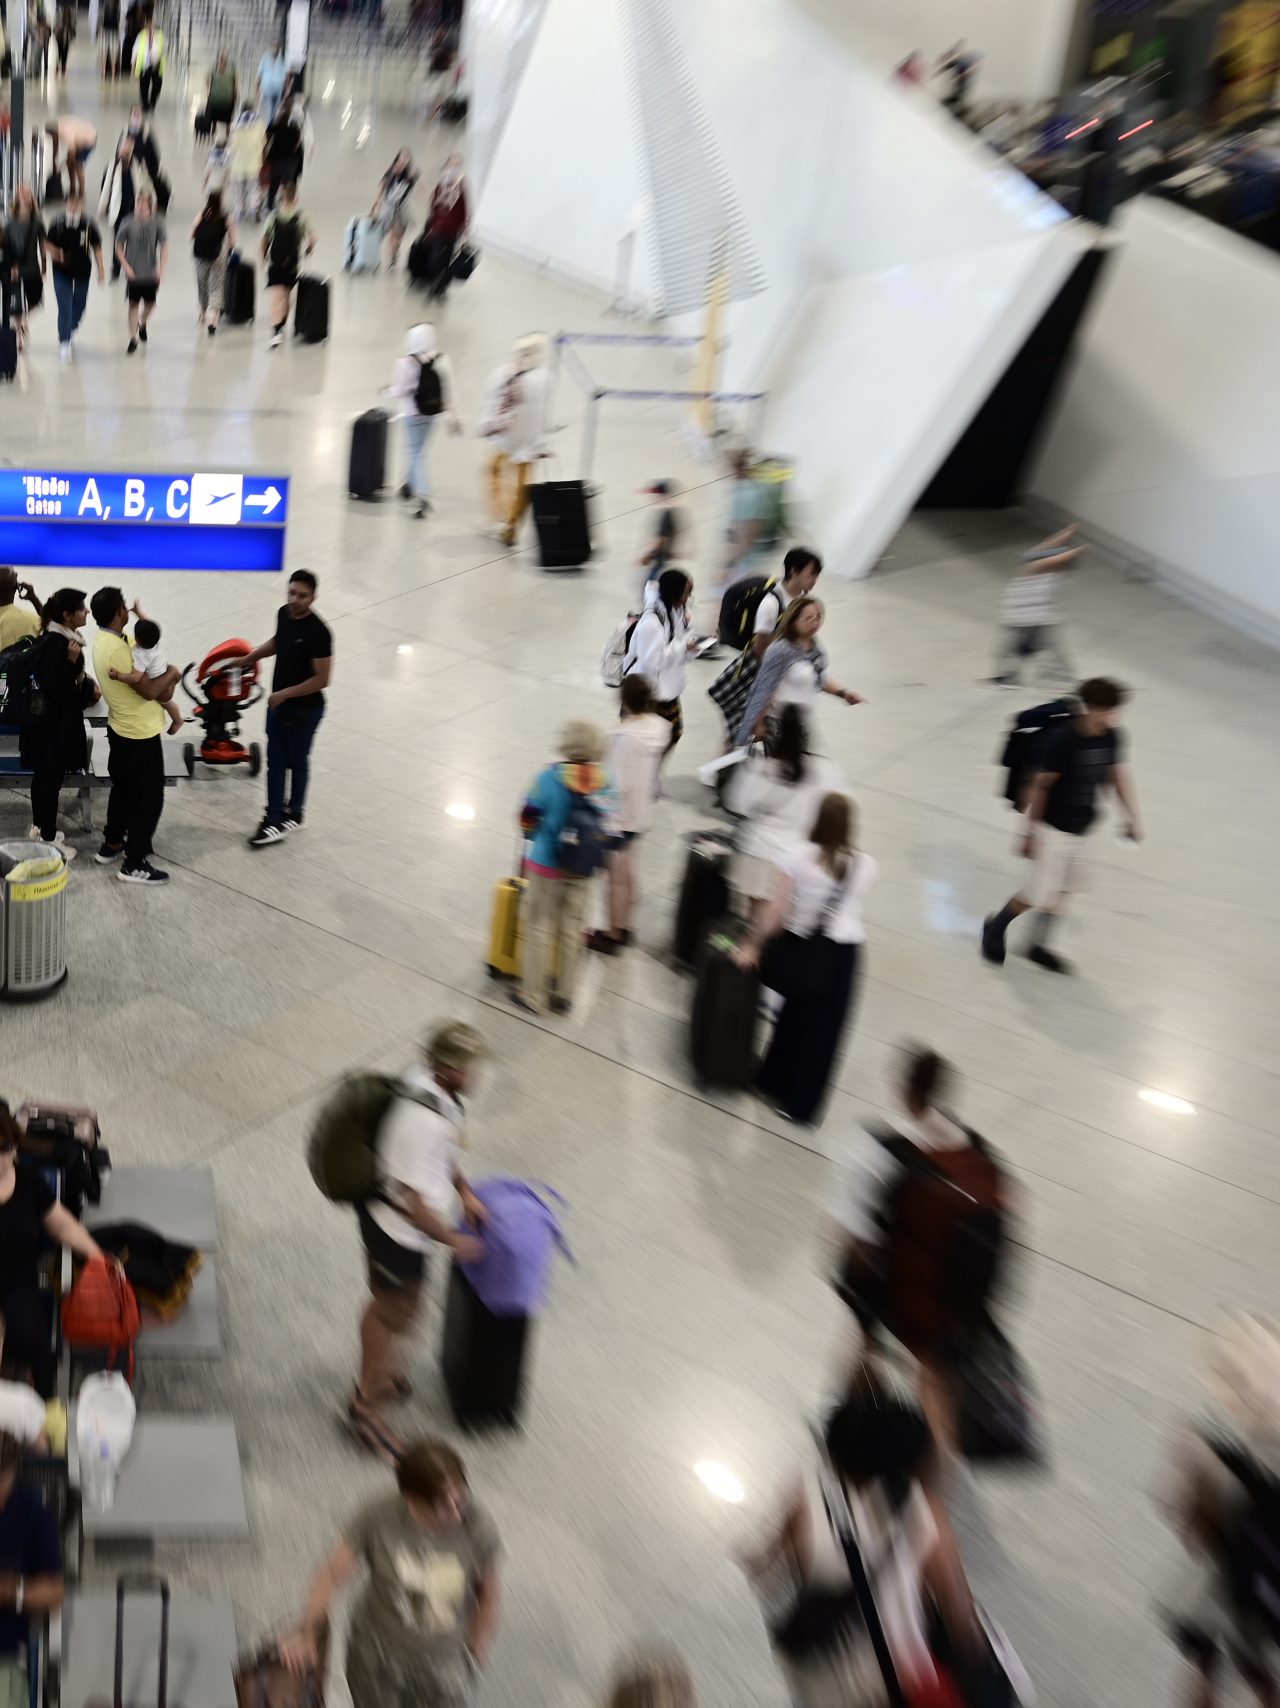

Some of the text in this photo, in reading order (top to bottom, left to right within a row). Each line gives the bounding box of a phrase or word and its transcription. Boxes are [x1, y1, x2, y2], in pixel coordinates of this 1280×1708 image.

[77, 478, 189, 522] A, B, C
